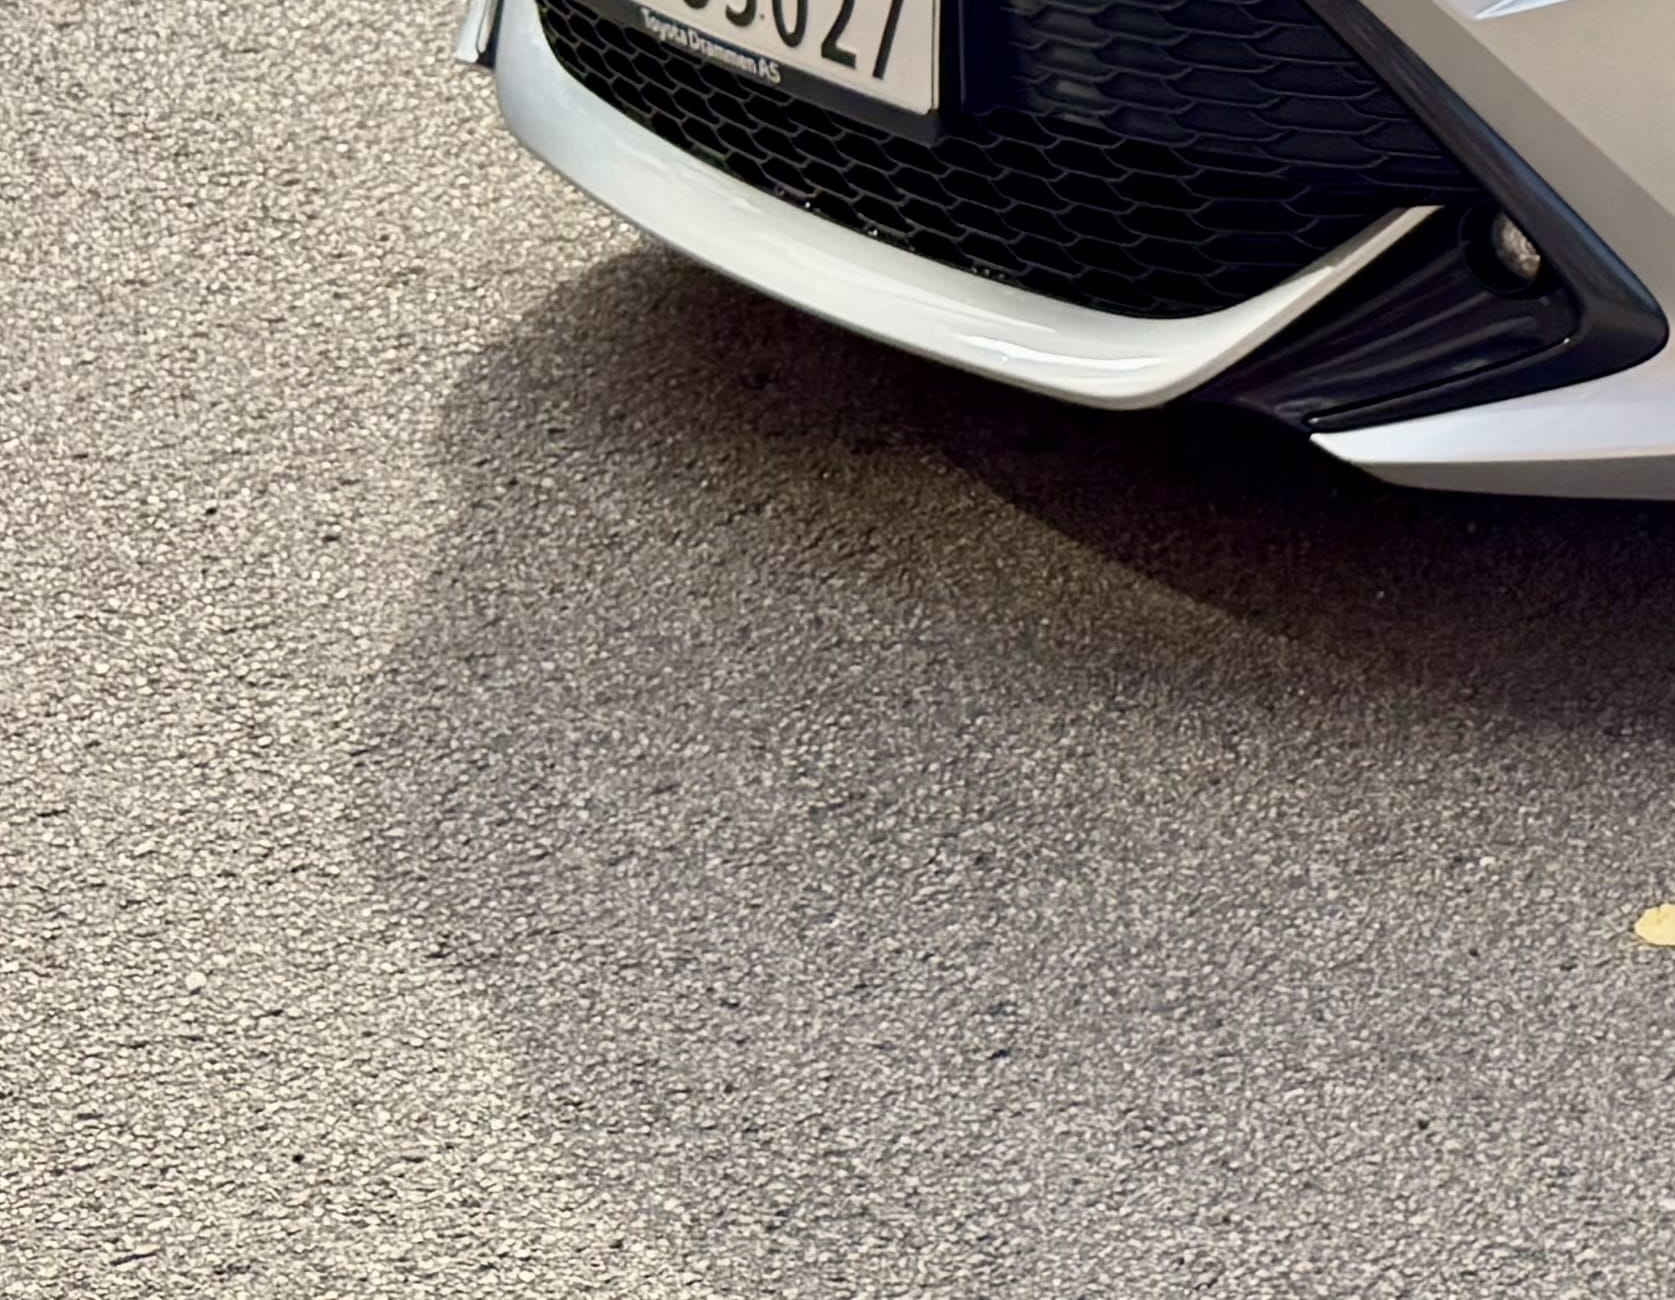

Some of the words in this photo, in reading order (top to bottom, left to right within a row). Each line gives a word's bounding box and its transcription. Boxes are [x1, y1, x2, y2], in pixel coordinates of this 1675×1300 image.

[640, 7, 688, 47] Toyota
[688, 29, 758, 75] Drammen
[758, 57, 782, 84] AS
